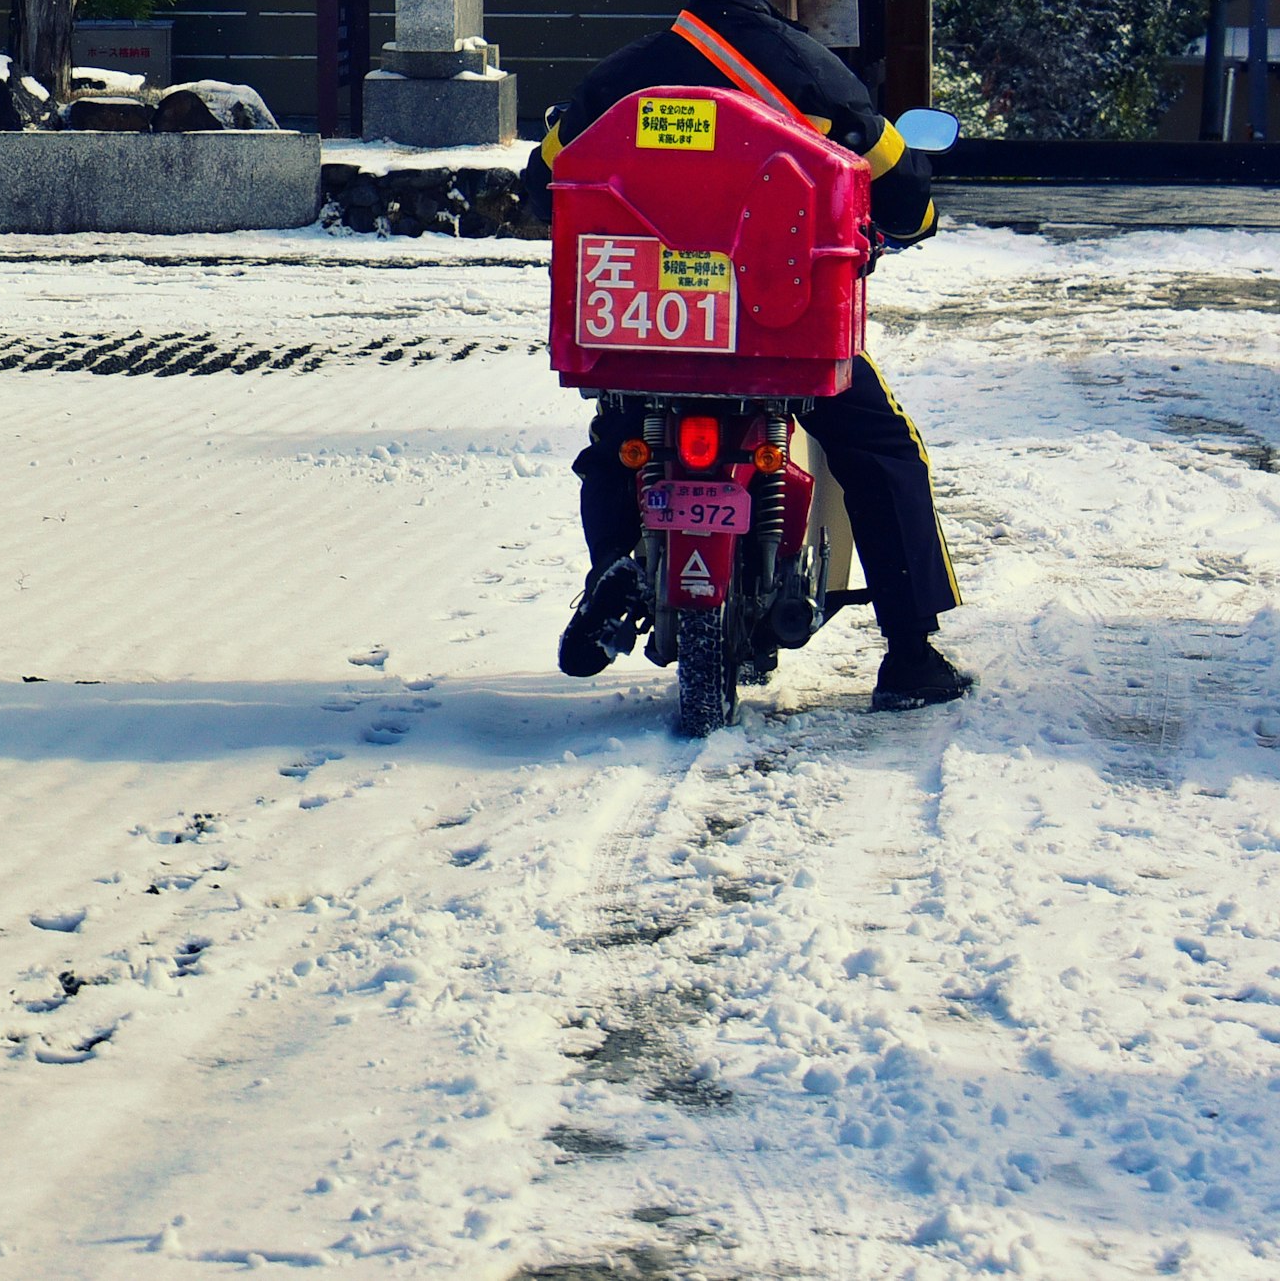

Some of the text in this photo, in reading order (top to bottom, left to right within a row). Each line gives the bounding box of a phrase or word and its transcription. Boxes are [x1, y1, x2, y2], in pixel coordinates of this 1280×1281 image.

[659, 104, 694, 115] 安全のため
[642, 116, 710, 133] 多段階一時停止を
[658, 133, 692, 144] 実施します
[585, 240, 635, 289] 左
[663, 260, 726, 276] 多段階一時停止を
[585, 290, 715, 341] 3401
[676, 486, 717, 497] 京都市
